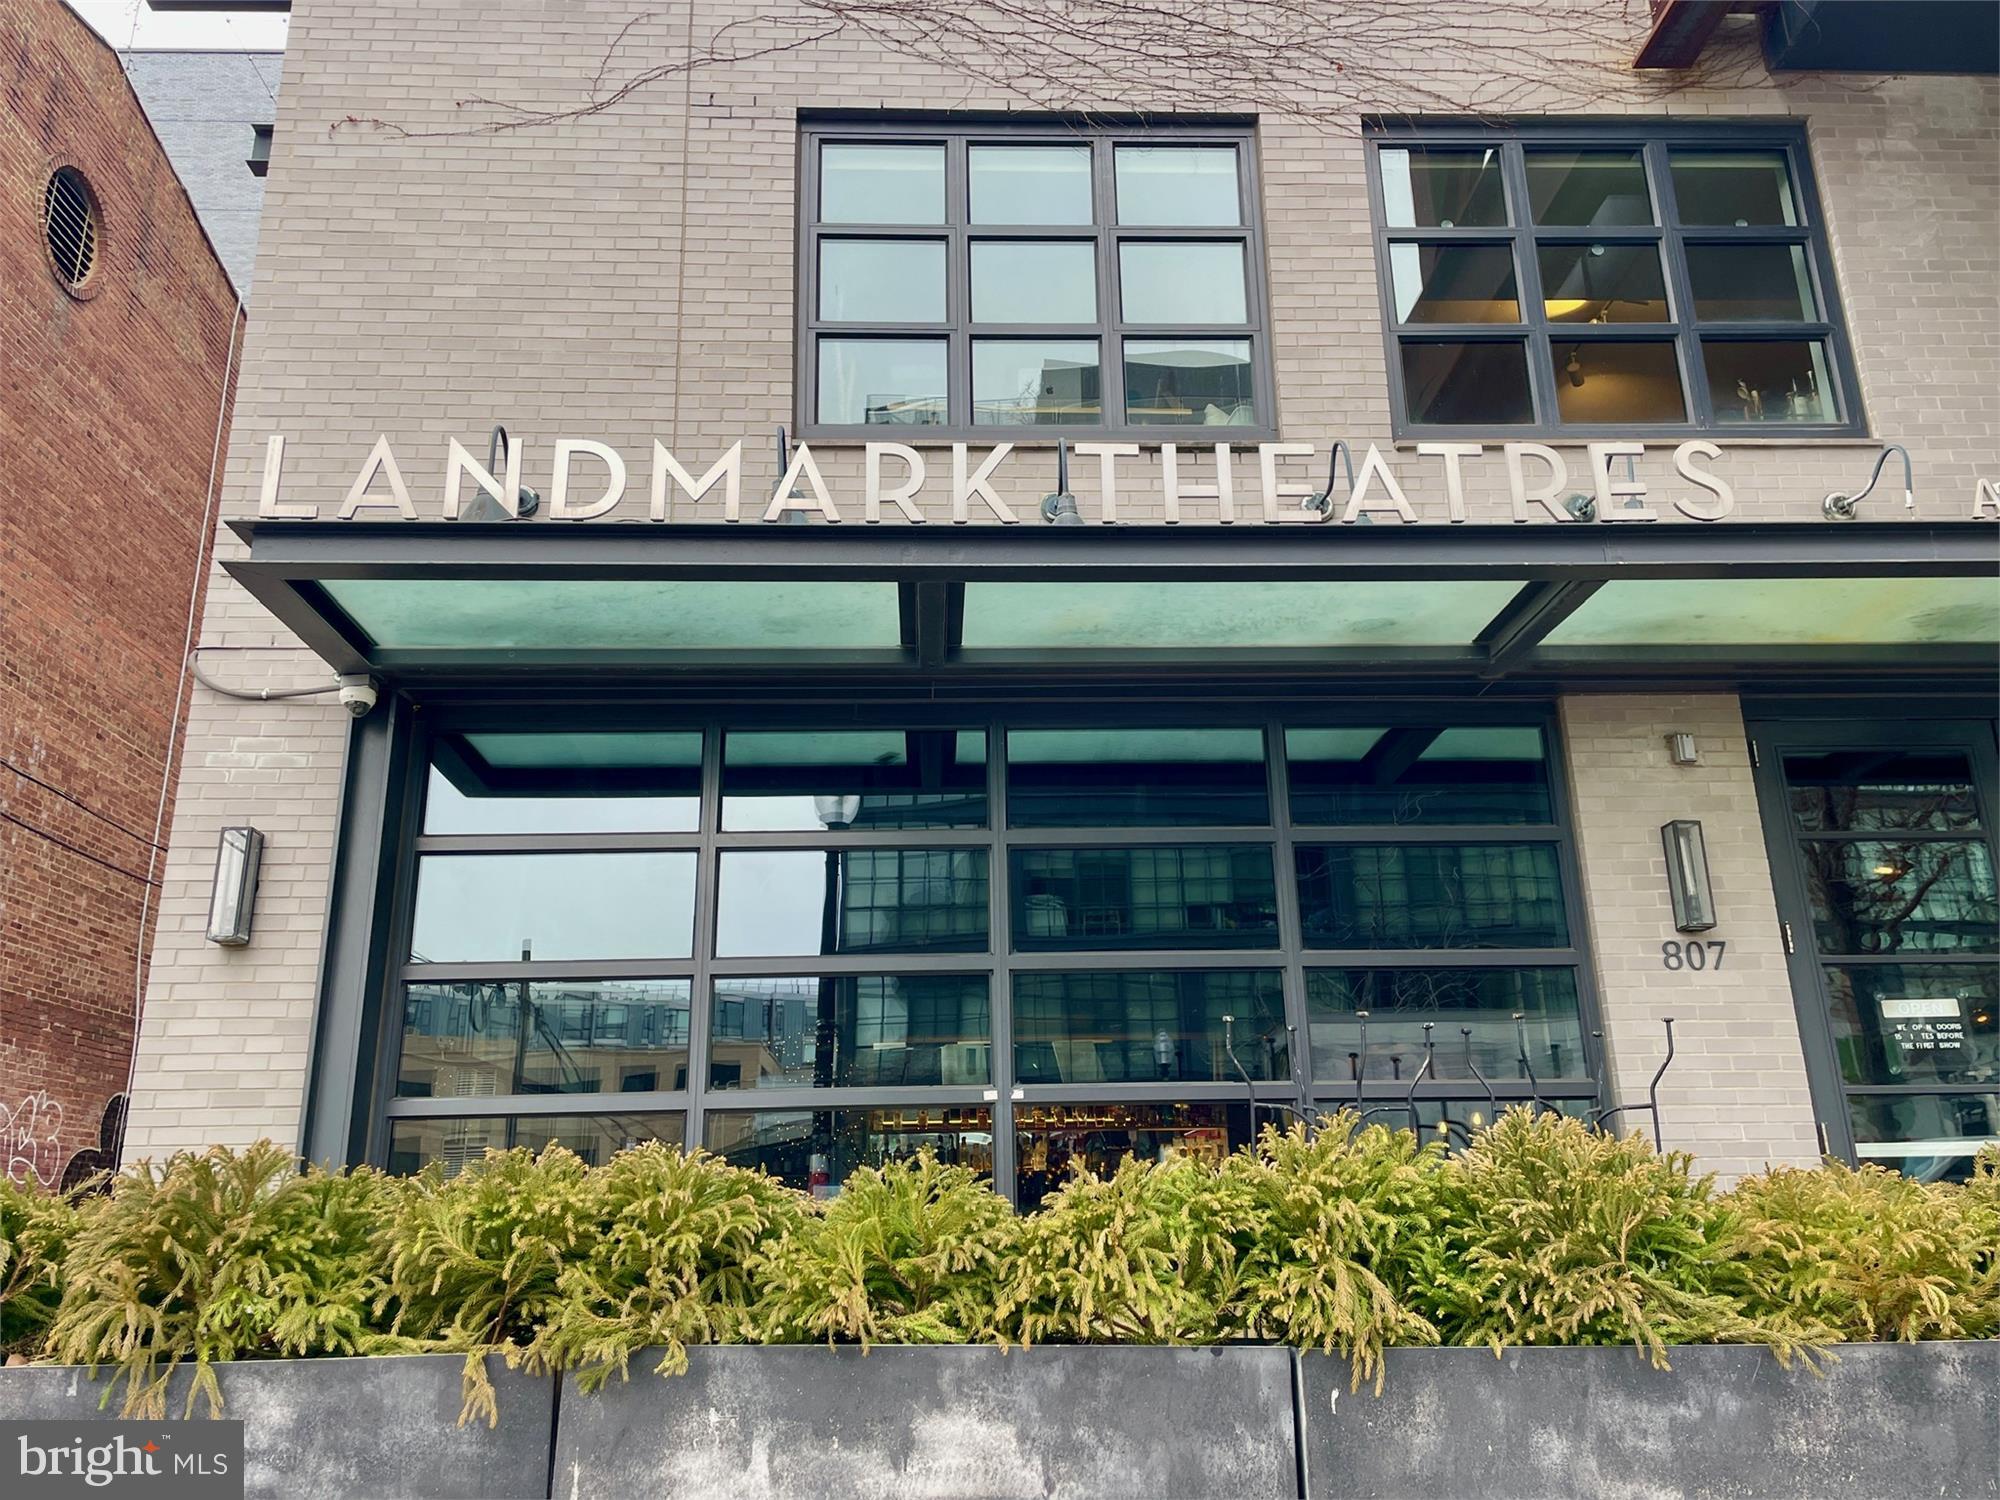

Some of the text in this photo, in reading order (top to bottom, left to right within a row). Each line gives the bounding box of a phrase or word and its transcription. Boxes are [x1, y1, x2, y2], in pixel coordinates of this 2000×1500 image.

[257, 433, 1021, 524] LANDMARK
[1074, 440, 1735, 524] THEATRES
[1662, 941, 1726, 971] 807
[1897, 1002, 1945, 1015] OPEN
[1936, 1032, 1965, 1040] BEFORE
[1901, 1042, 1915, 1050] THE
[1939, 1041, 1961, 1049] SHOW
